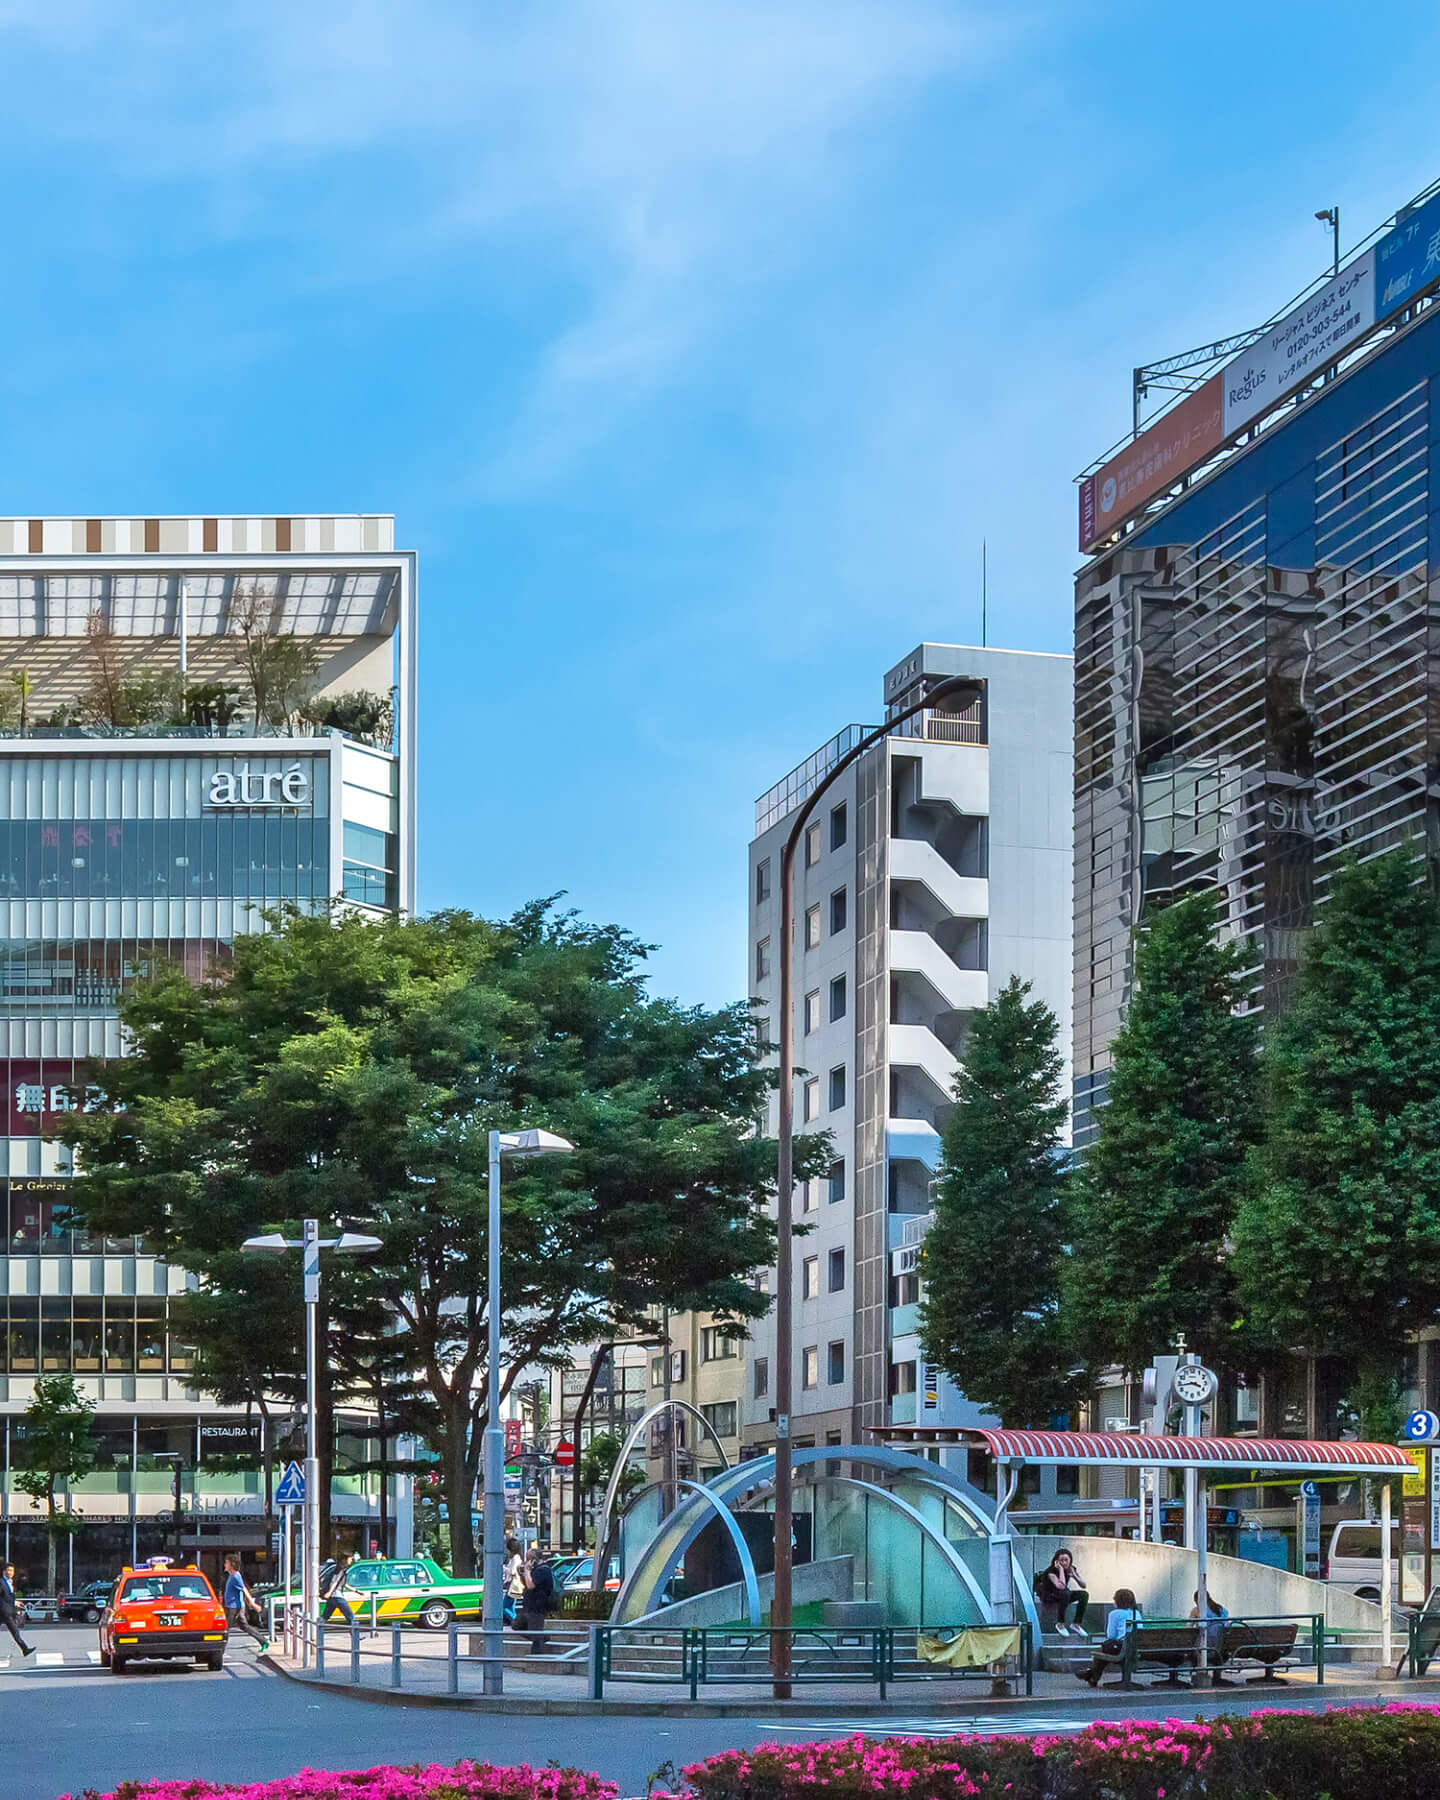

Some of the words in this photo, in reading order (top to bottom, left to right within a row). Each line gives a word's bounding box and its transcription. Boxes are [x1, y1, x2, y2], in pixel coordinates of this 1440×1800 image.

[1286, 299, 1352, 359] 0120-303-544
[1229, 369, 1266, 408] Regus
[209, 762, 308, 803] atré
[15, 1082, 129, 1113] 無印
[1411, 1413, 1427, 1436] 3
[1306, 1482, 1315, 1494] 4
